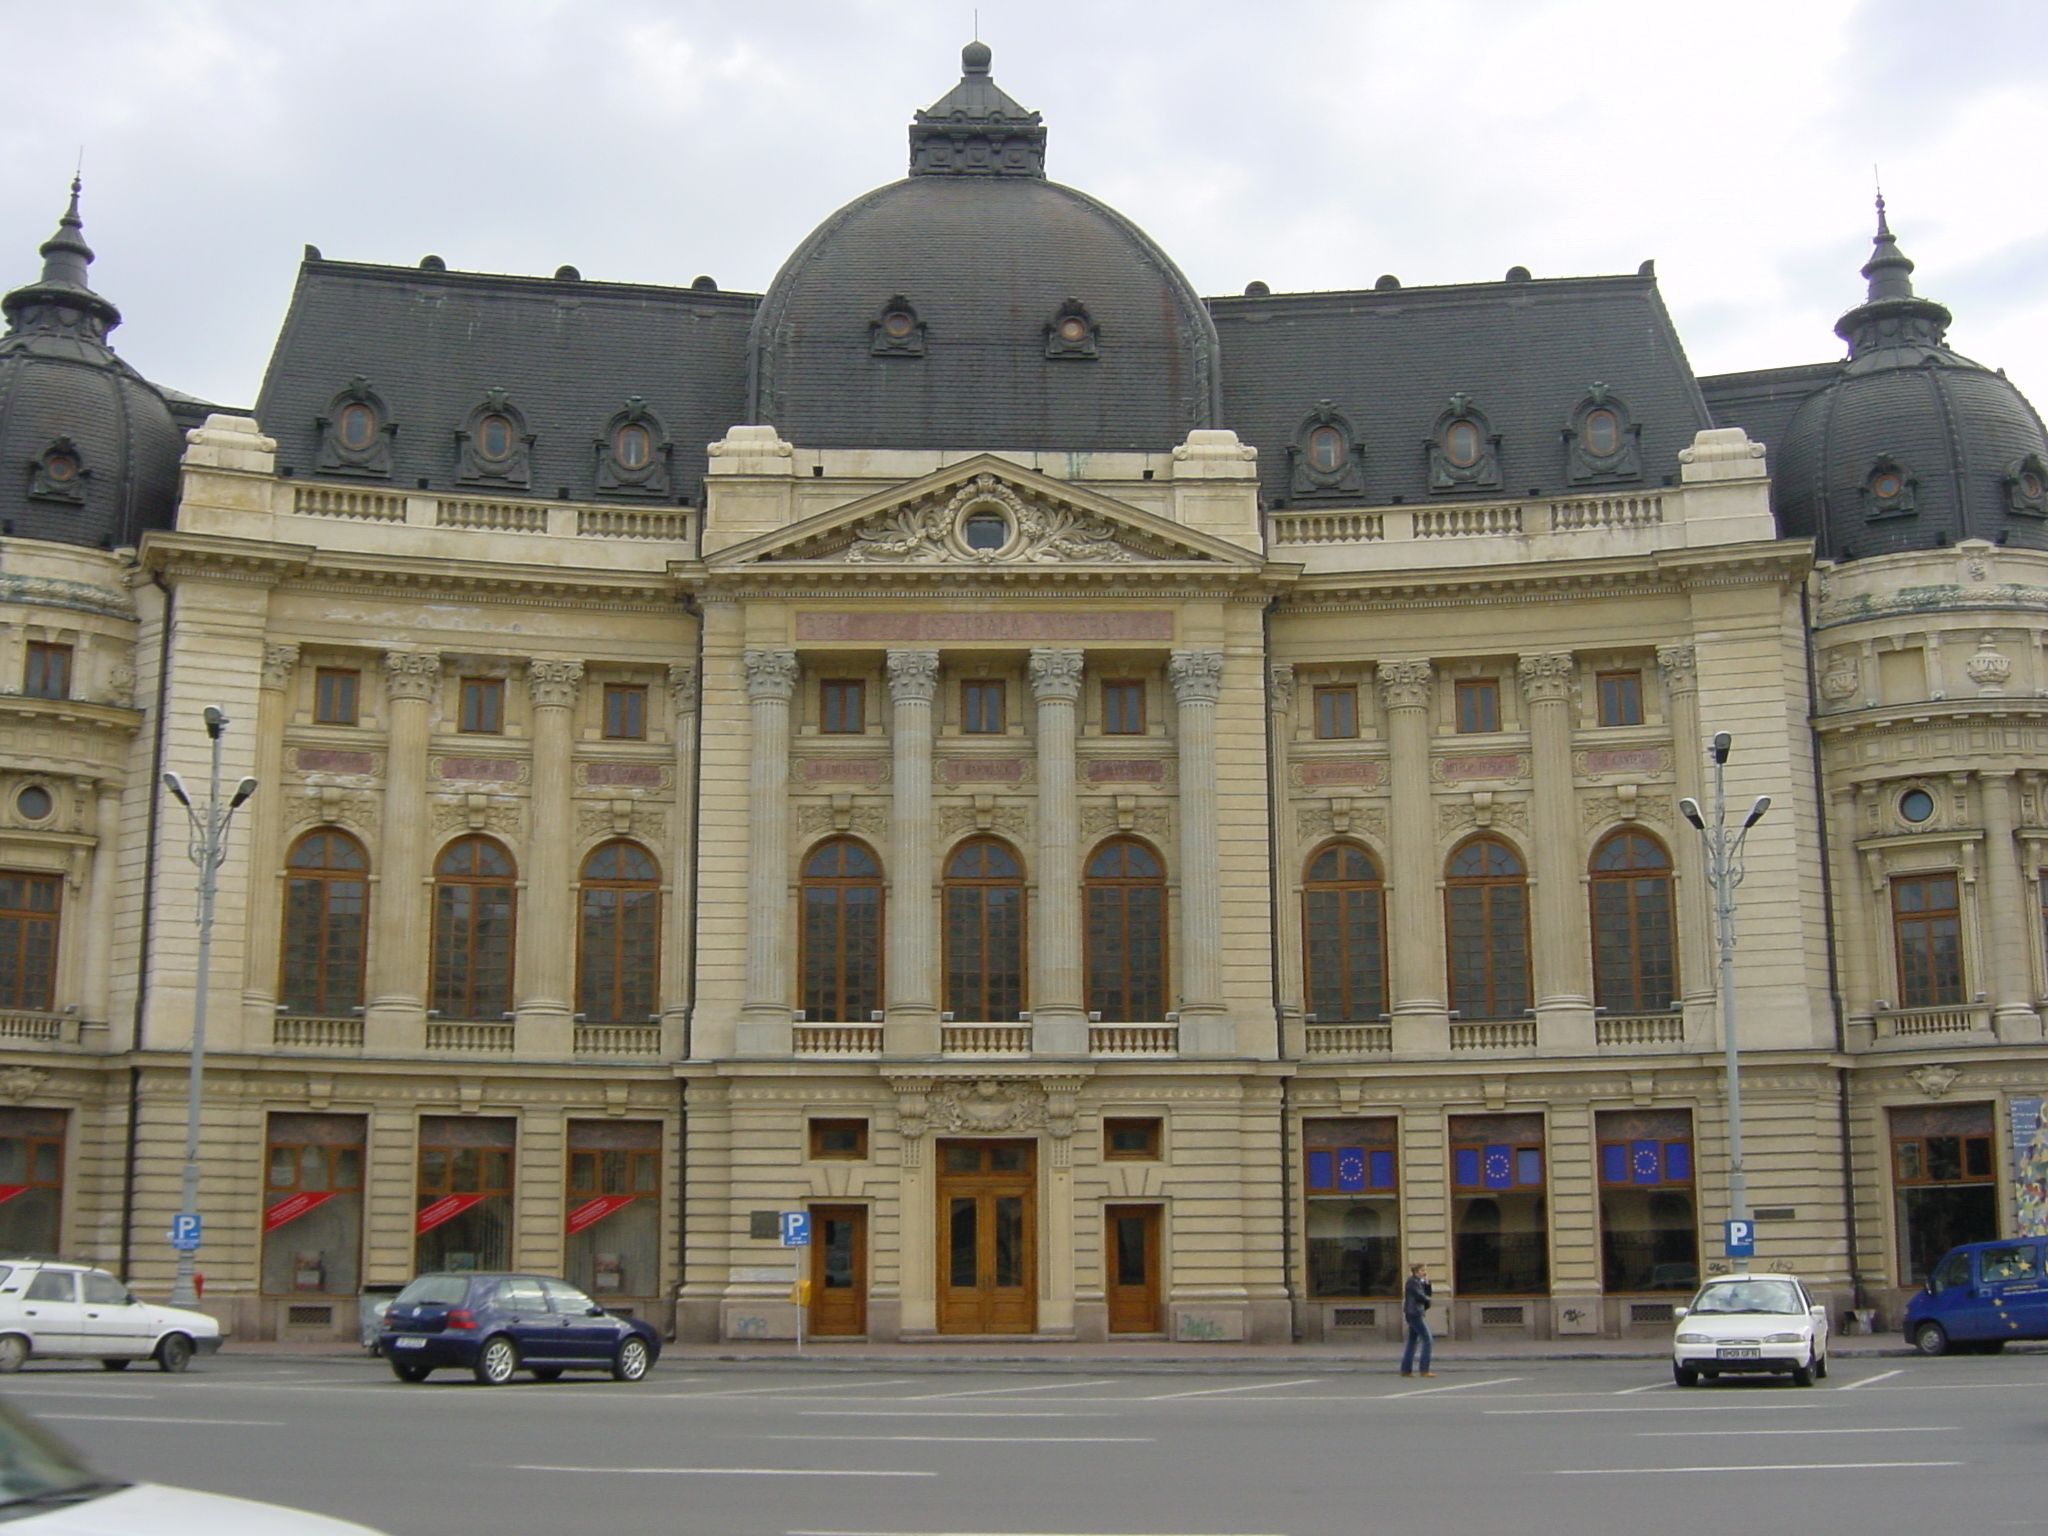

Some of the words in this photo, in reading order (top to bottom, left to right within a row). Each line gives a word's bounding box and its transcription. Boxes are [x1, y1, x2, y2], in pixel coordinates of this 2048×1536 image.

[180, 1217, 195, 1239] P
[788, 1214, 804, 1236] P
[1730, 1222, 1747, 1246] P
